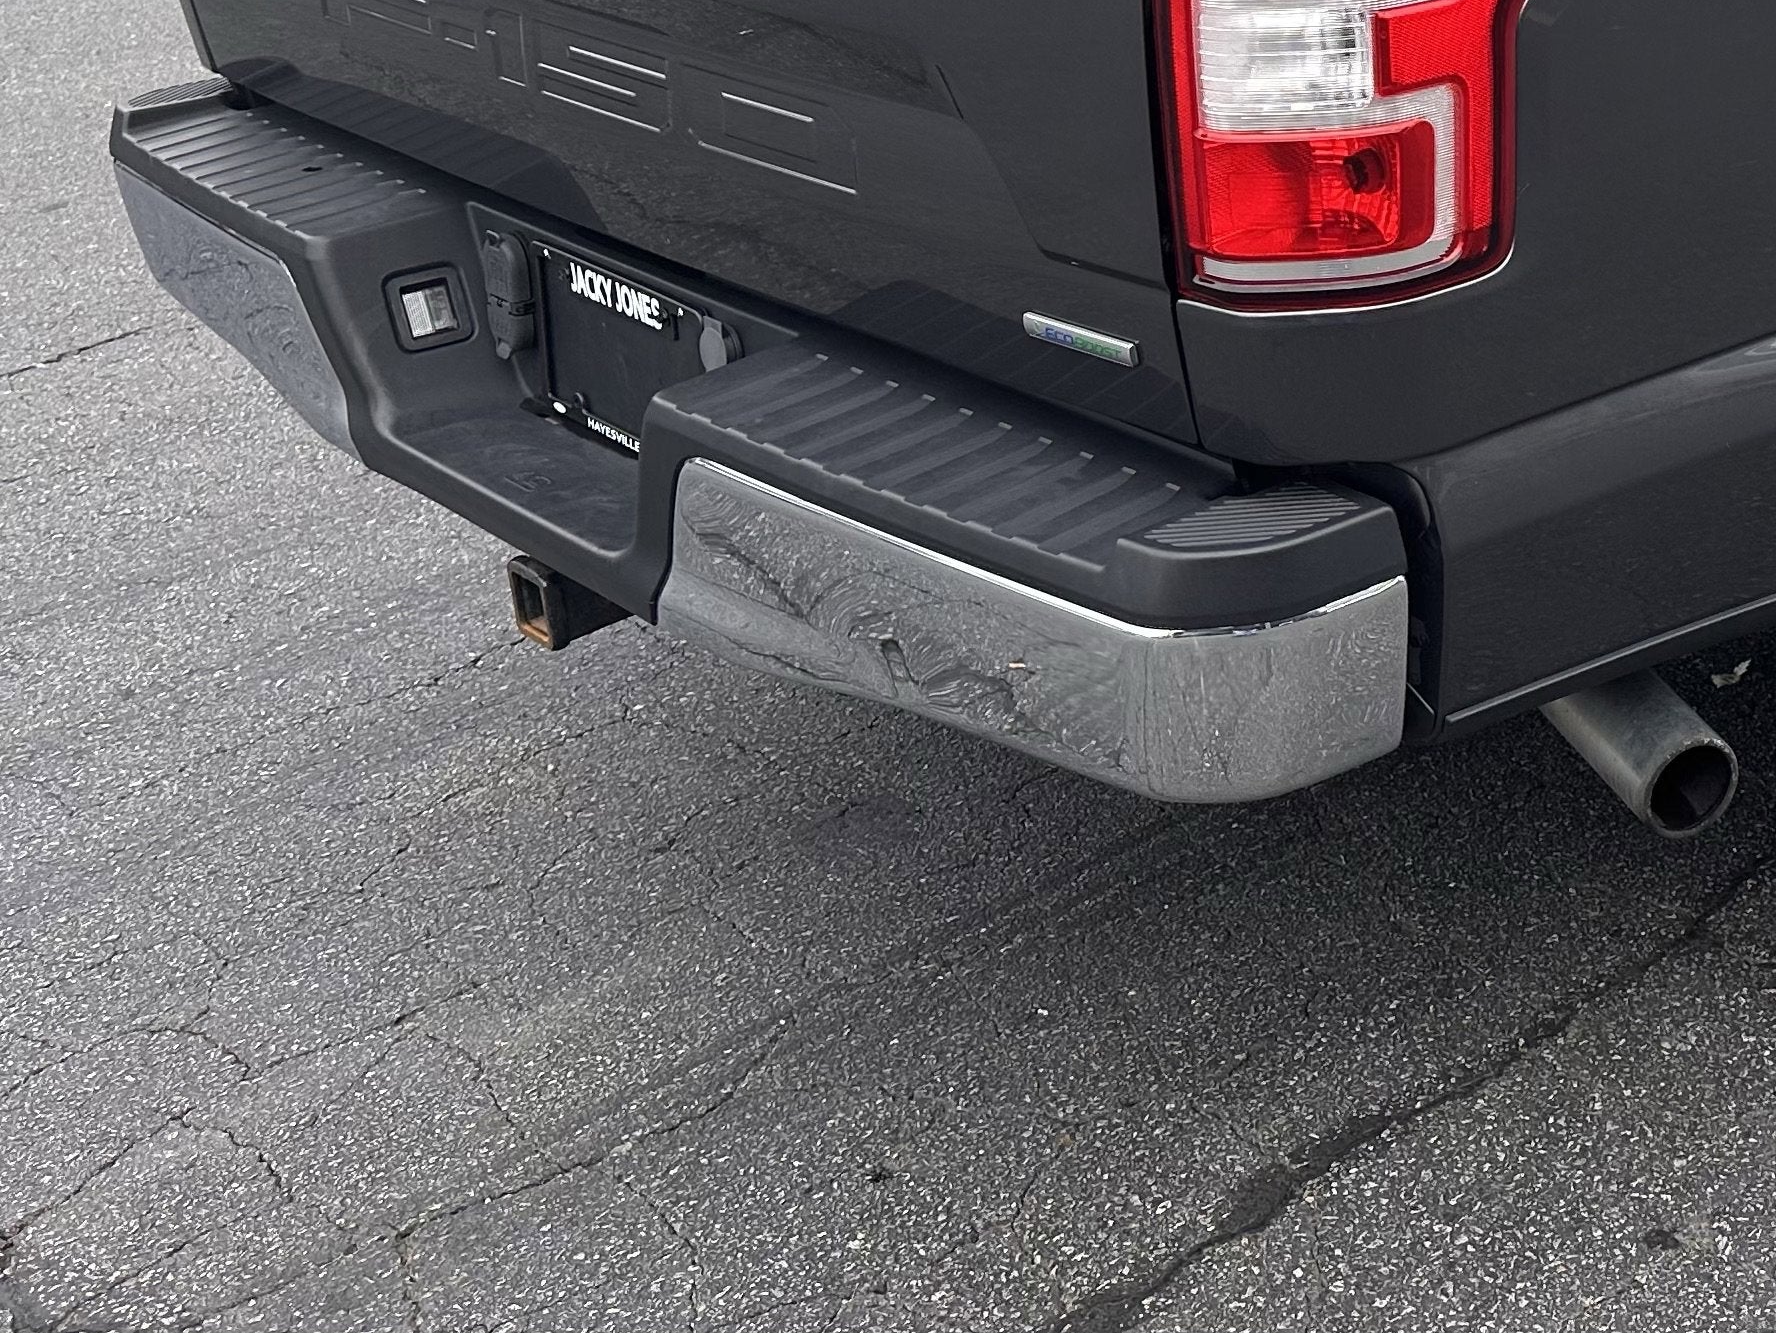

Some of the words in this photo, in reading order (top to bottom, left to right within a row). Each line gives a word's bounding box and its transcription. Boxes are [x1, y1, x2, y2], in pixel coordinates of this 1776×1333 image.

[569, 261, 613, 309] JACKY
[614, 281, 663, 330] JONES
[587, 417, 641, 453] HAYESVILLE
